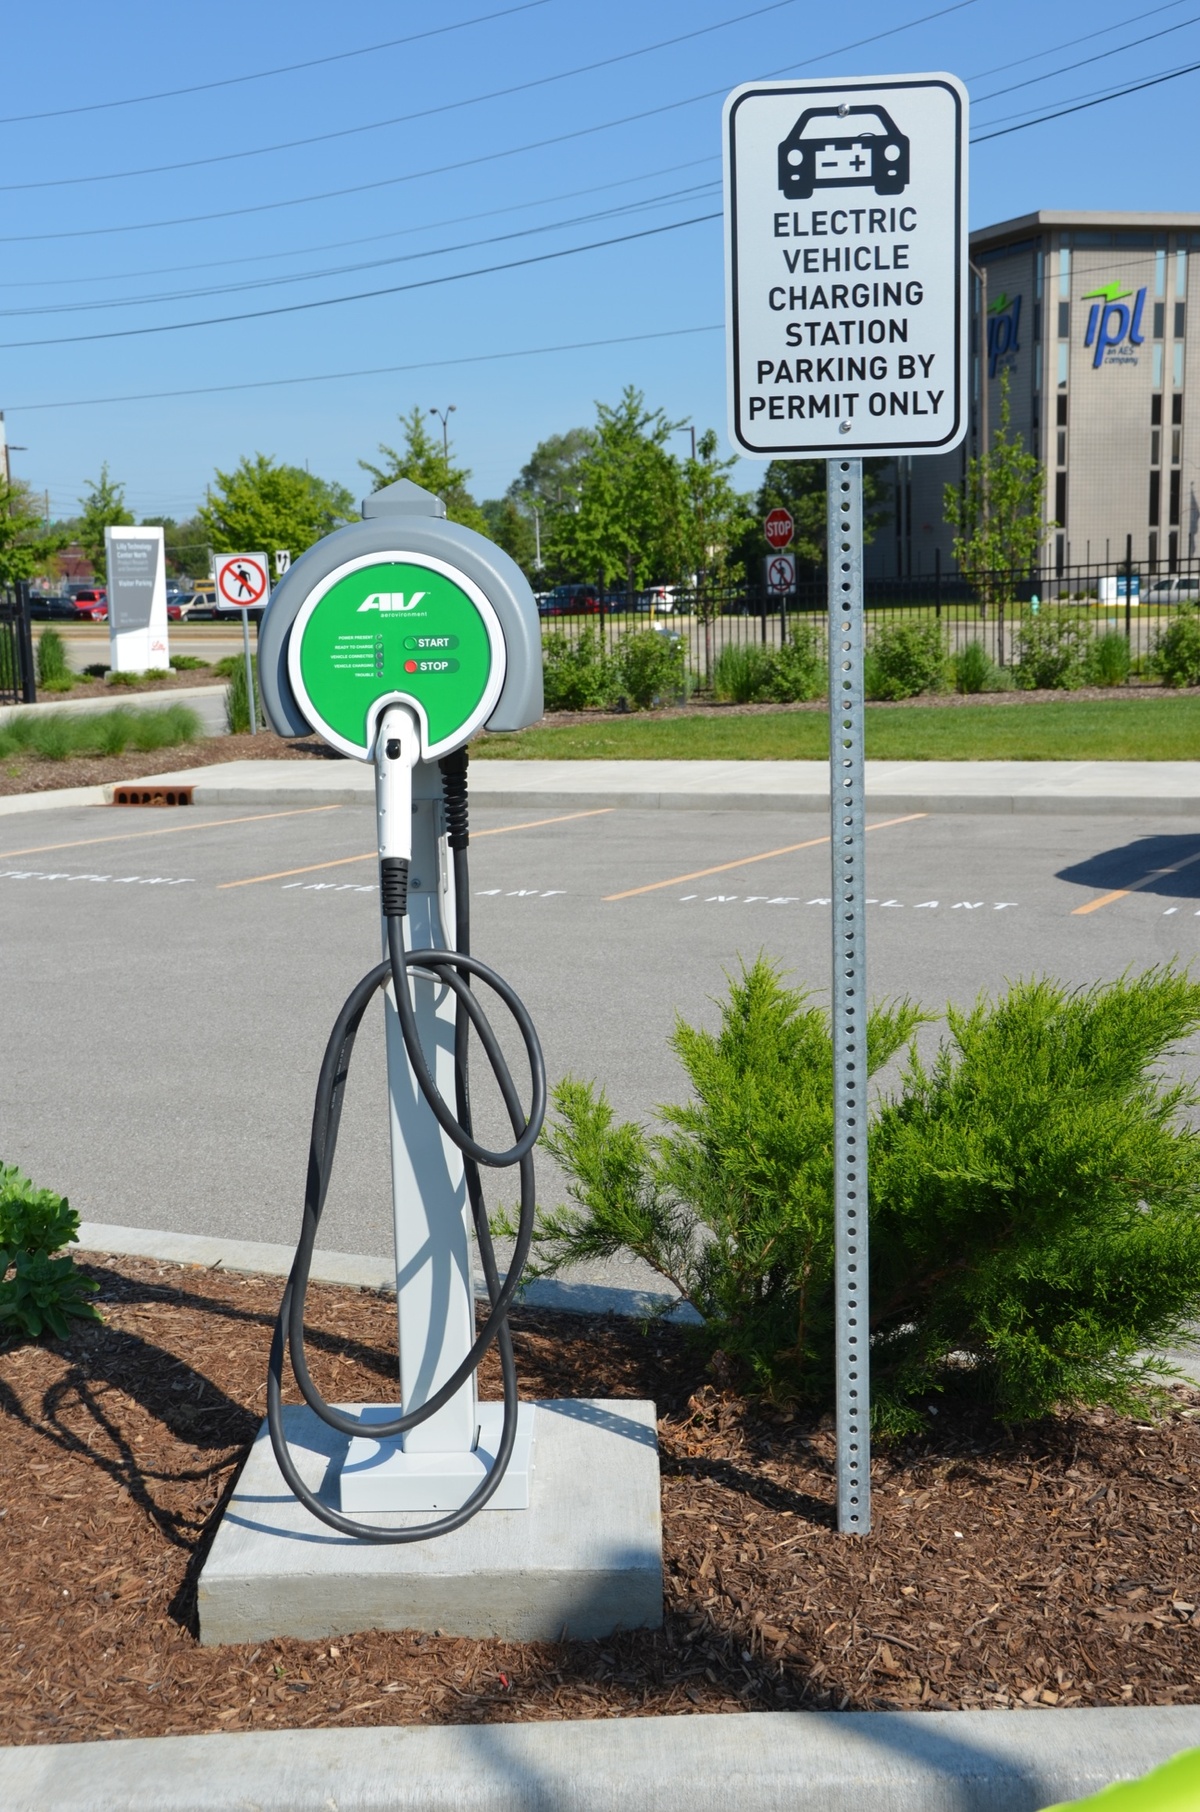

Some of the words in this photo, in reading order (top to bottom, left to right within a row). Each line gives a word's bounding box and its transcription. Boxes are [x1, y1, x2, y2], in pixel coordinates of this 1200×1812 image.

[773, 206, 917, 238] ELECTRIC
[782, 244, 910, 274] VEHICLE
[768, 280, 924, 312] CHARGING
[785, 318, 908, 347] STATION
[757, 355, 888, 385] PARKING
[899, 353, 936, 380] BY
[748, 392, 860, 421] PERMIT
[868, 389, 945, 416] ONLY
[766, 520, 792, 537] STOP
[118, 580, 135, 588] Visitor
[135, 579, 153, 588] Parking
[418, 637, 449, 648] START
[420, 661, 449, 671] STOP
